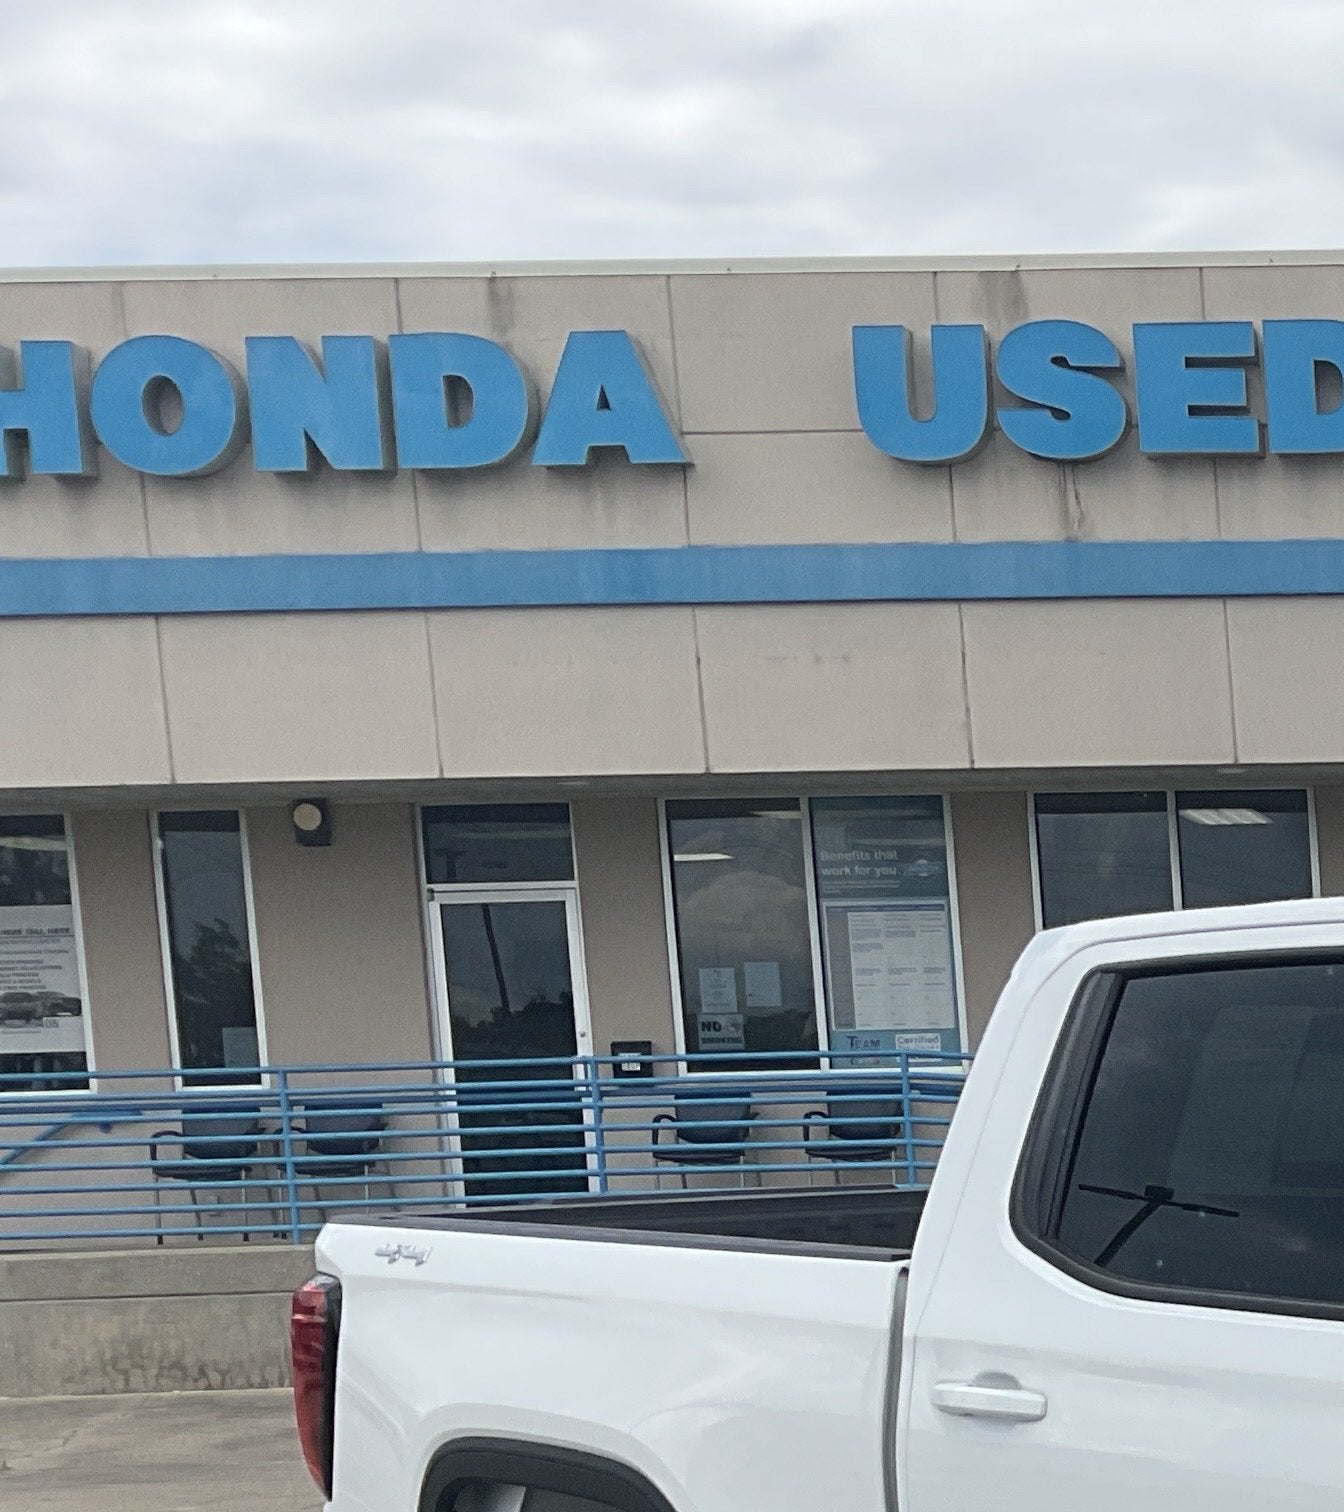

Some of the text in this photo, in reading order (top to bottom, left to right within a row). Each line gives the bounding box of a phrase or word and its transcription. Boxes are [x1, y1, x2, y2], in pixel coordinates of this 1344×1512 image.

[0, 330, 690, 478] HONDA
[820, 849, 898, 861] Benefits that
[821, 867, 851, 876] work
[855, 865, 871, 876] for
[874, 867, 898, 878] you
[701, 1021, 722, 1032] NO
